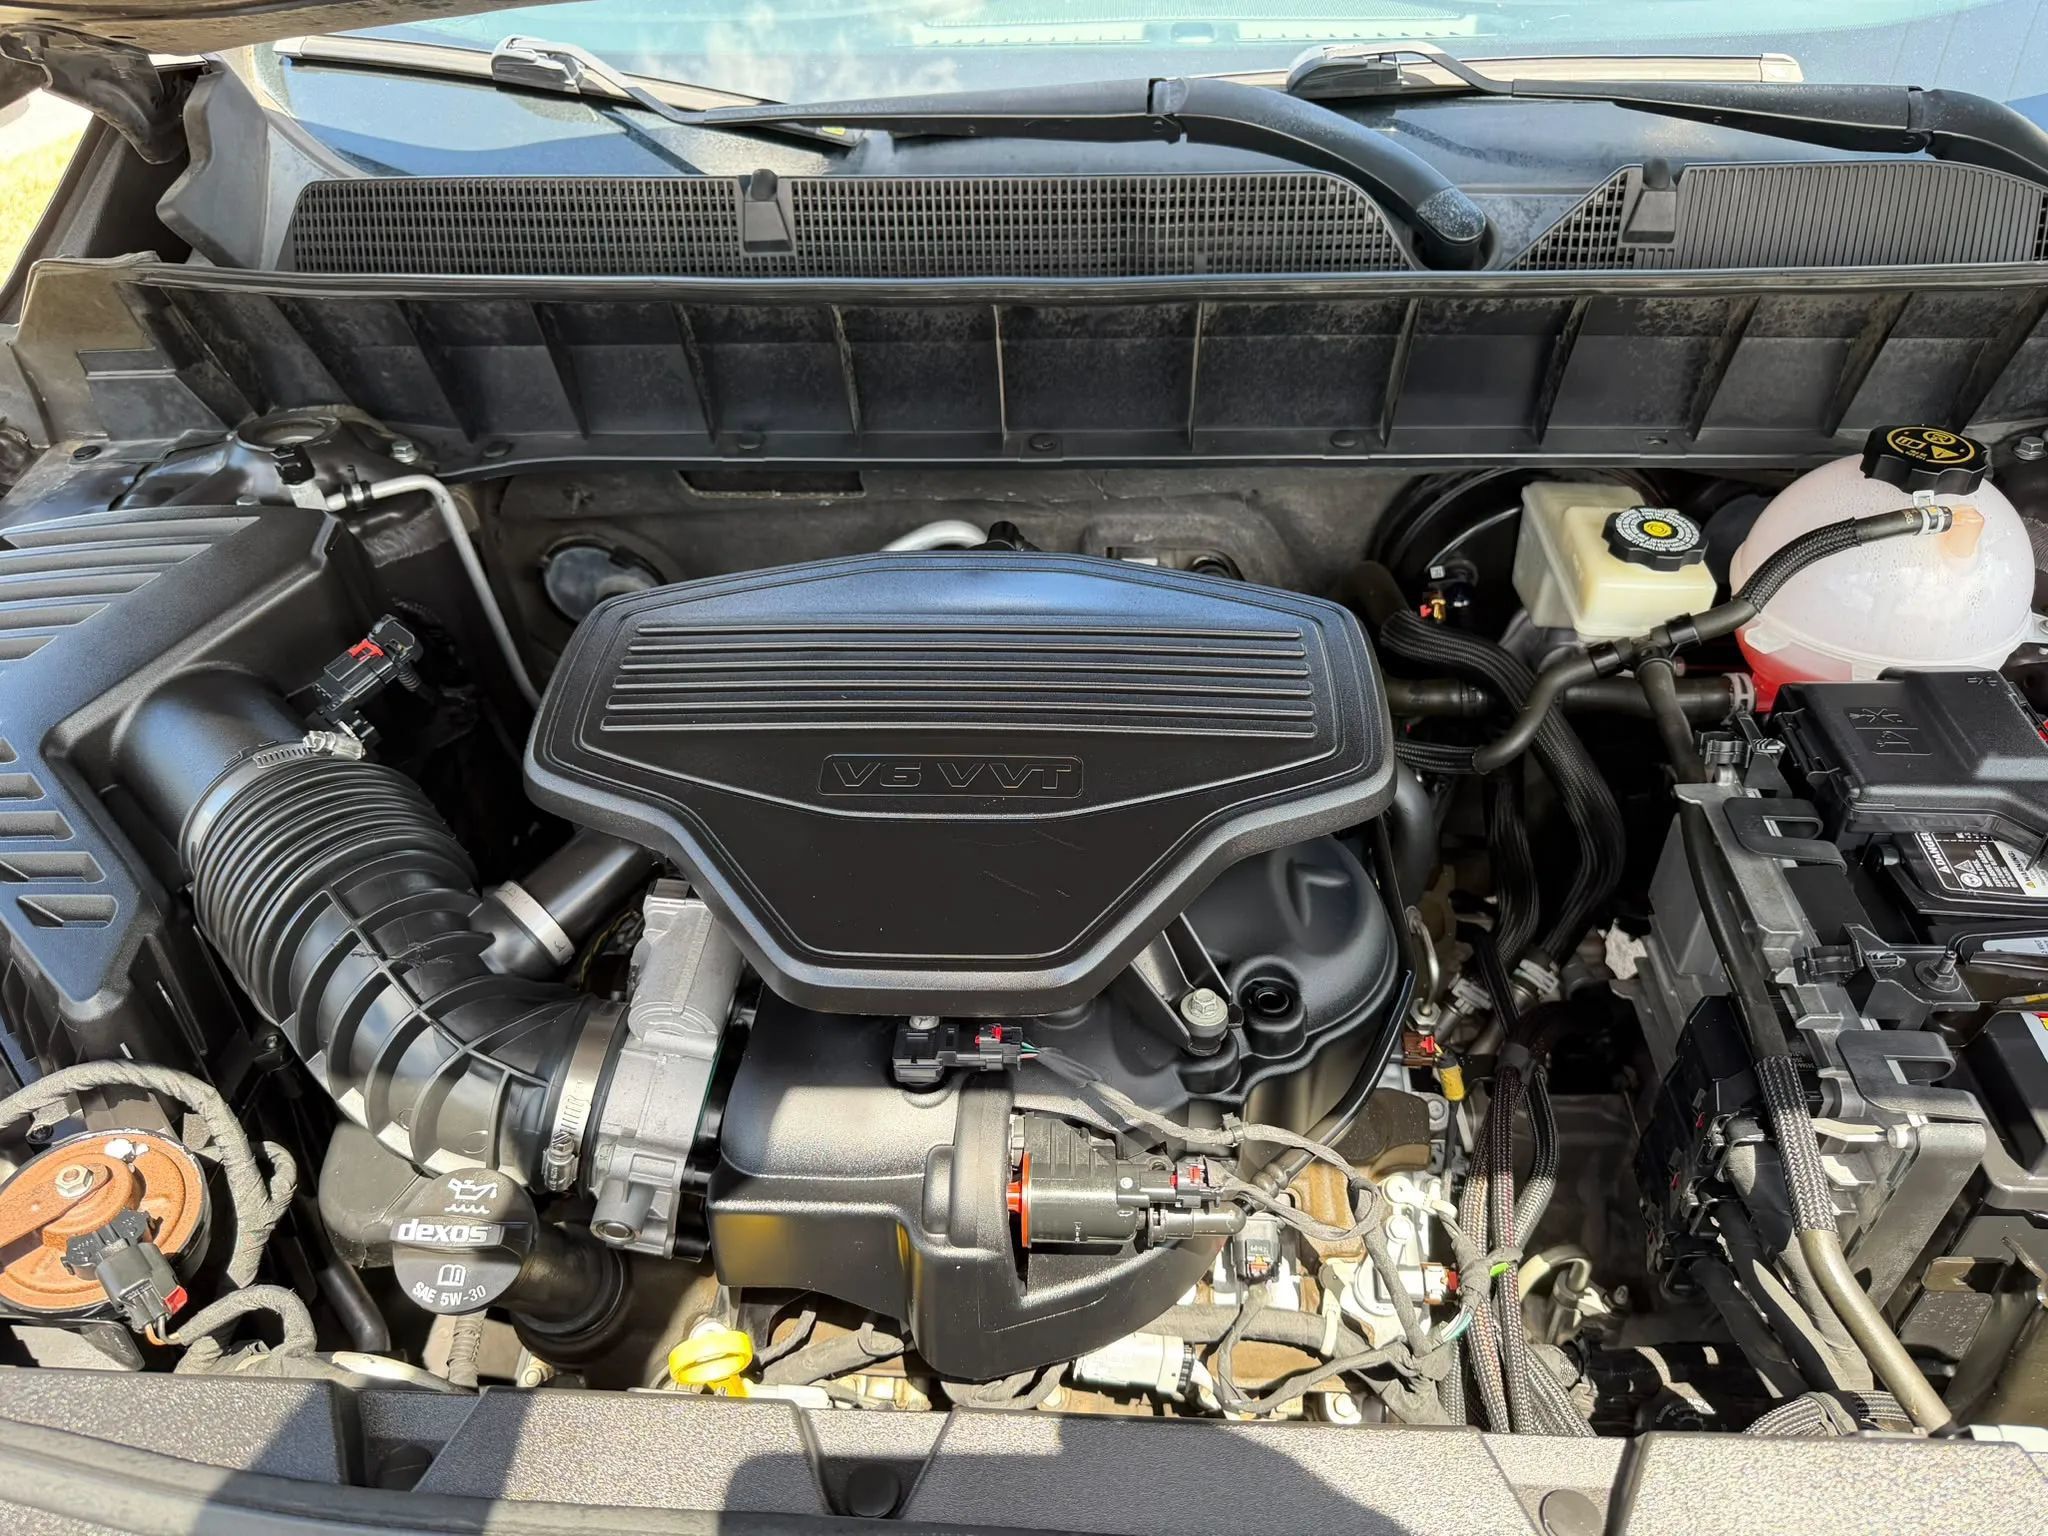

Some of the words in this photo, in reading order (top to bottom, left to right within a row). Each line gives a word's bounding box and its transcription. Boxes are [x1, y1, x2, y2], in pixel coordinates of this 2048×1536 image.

[833, 762, 922, 787] V6
[937, 763, 1072, 790] VVT
[398, 1219, 490, 1243] dexos
[412, 1281, 438, 1304] SAE
[439, 1284, 487, 1306] 5W-30
